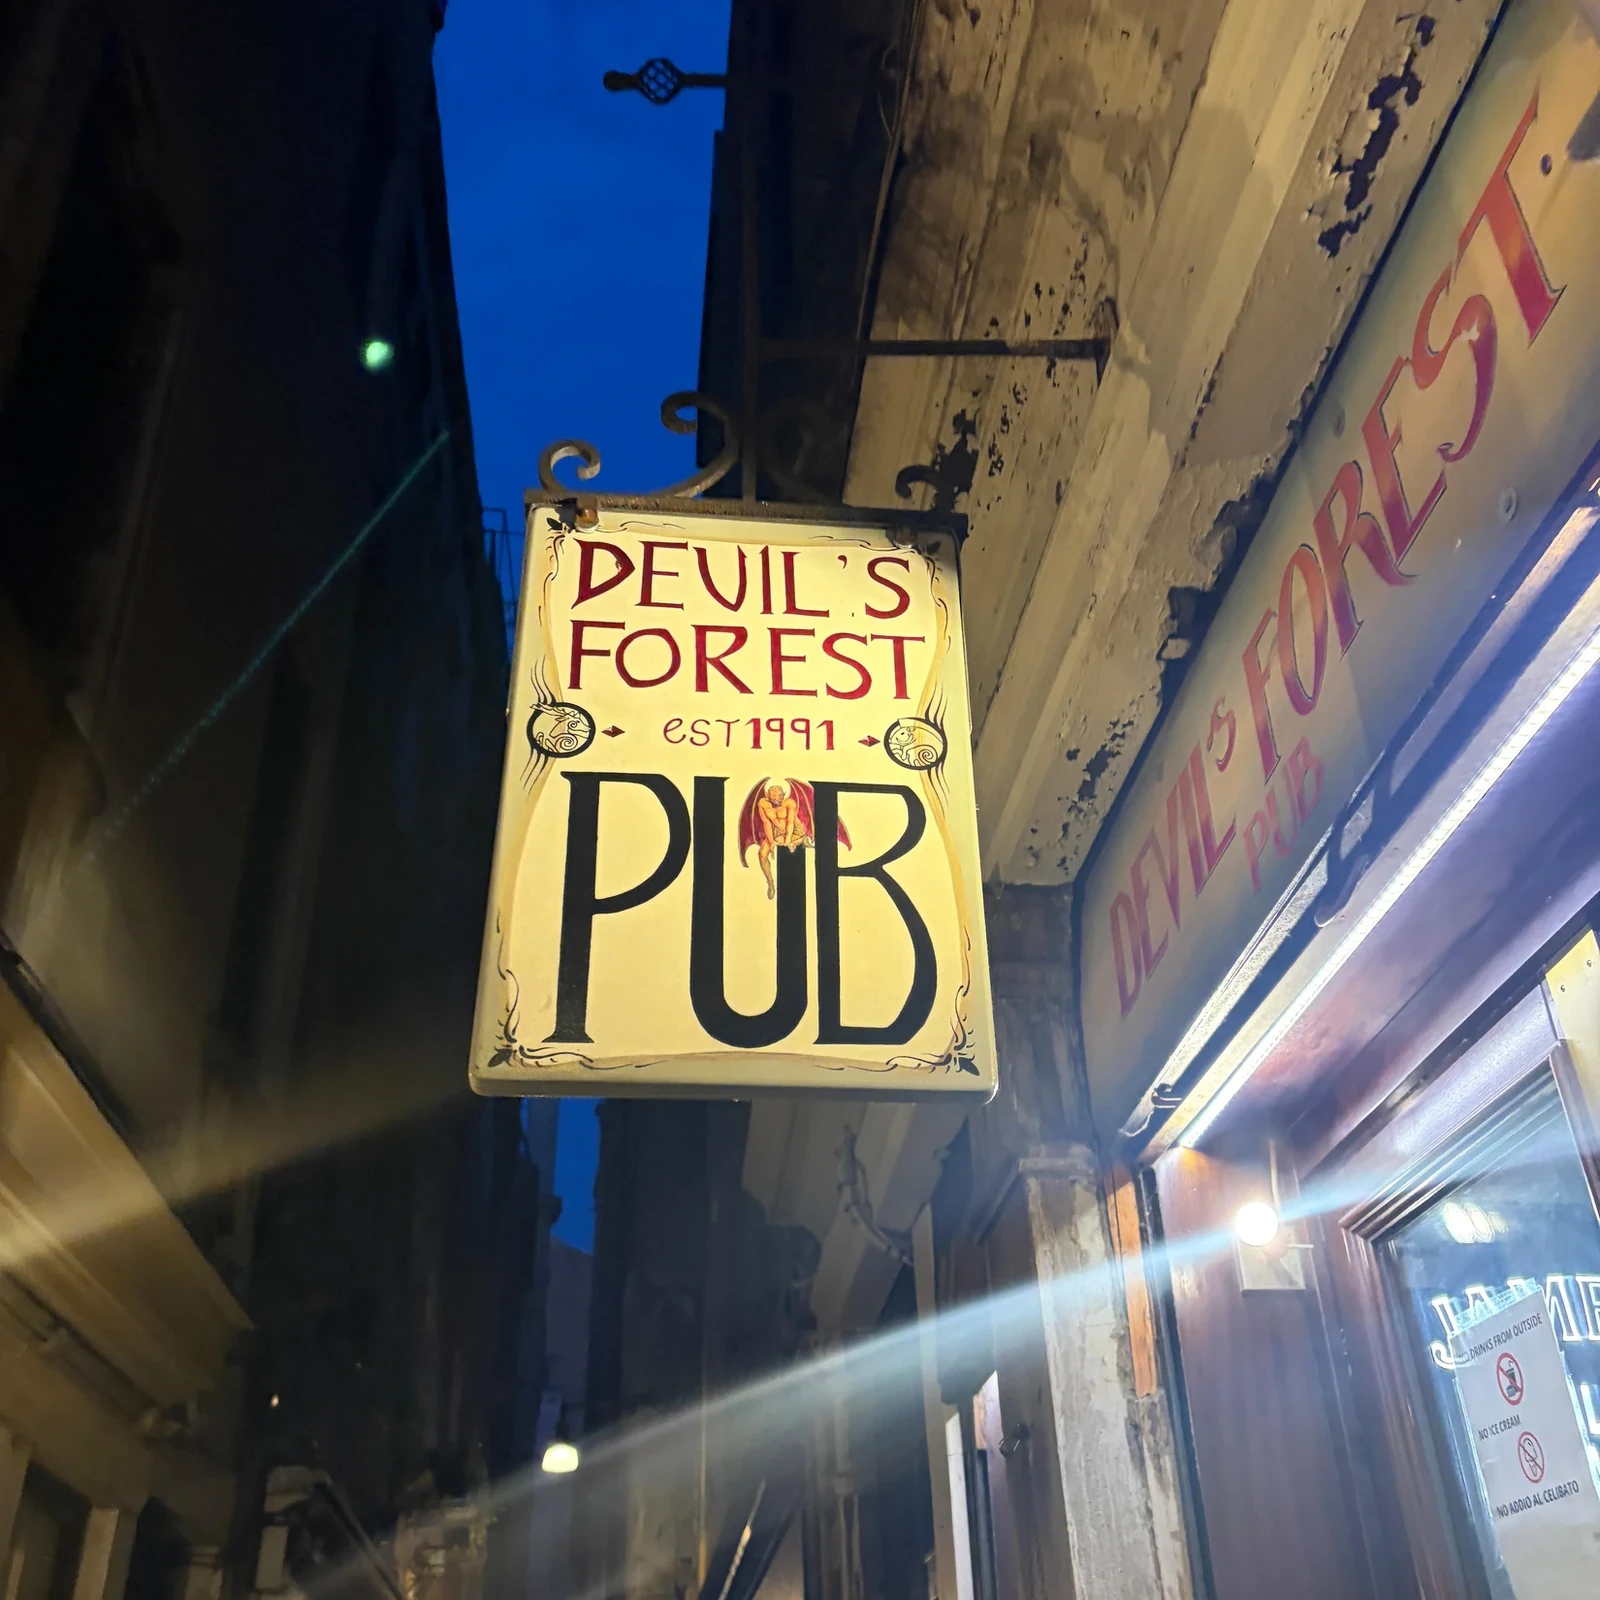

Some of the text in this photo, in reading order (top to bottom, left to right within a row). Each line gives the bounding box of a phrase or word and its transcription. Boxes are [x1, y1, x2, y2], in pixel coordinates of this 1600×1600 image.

[571, 537, 911, 619] DEVIL'S
[1108, 79, 1567, 1021] DEVIL'S FOREST
[567, 619, 926, 700] FOREST
[1242, 735, 1324, 893] PUB
[541, 770, 939, 1048] PUB
[1470, 1338, 1494, 1360] DRINKS
[1493, 1328, 1514, 1348] FROM
[1512, 1313, 1543, 1337] OUTSIDE
[1478, 1414, 1521, 1441] NO ICE CREAM
[1496, 1480, 1580, 1518] NO ADDIO AL CELIBATO
